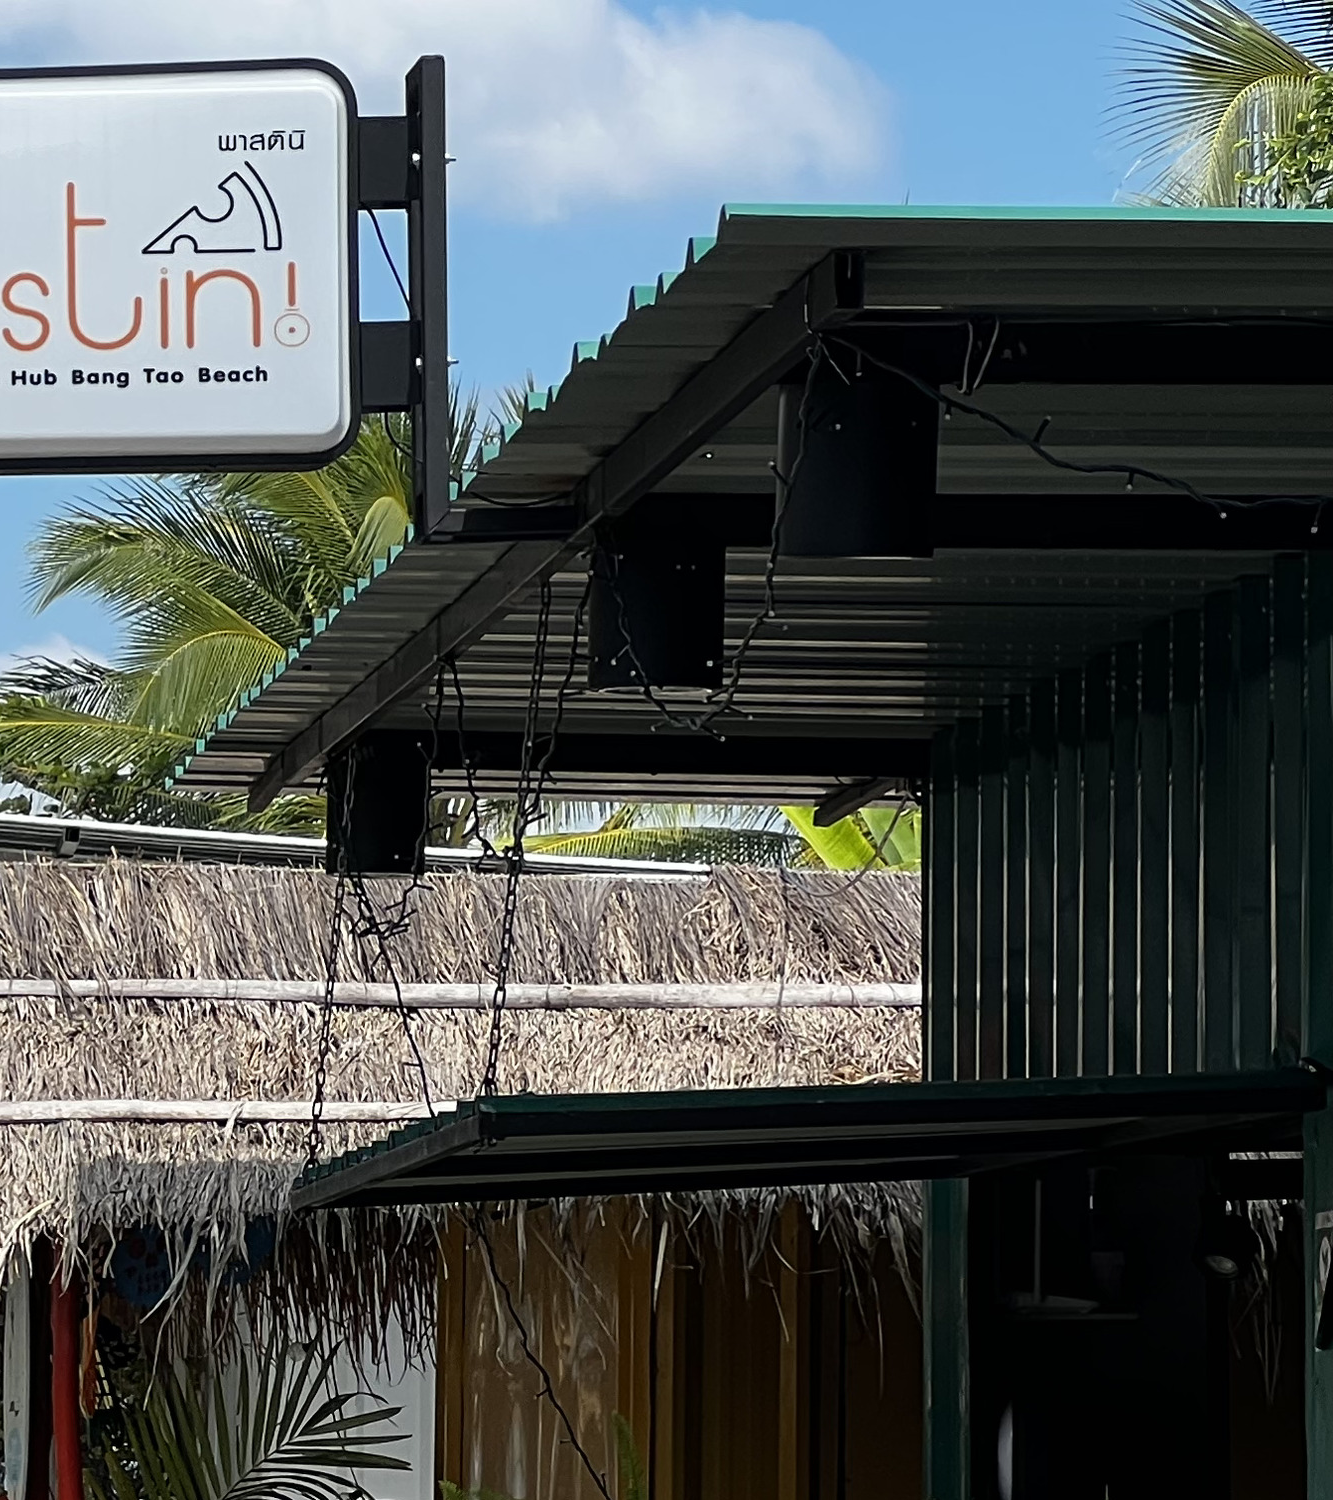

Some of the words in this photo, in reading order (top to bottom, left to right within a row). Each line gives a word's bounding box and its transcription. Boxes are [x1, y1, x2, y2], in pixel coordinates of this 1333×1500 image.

[11, 369, 57, 386] Hub
[71, 368, 130, 388] Bang
[143, 367, 184, 384] Tao
[198, 366, 268, 383] Beach
